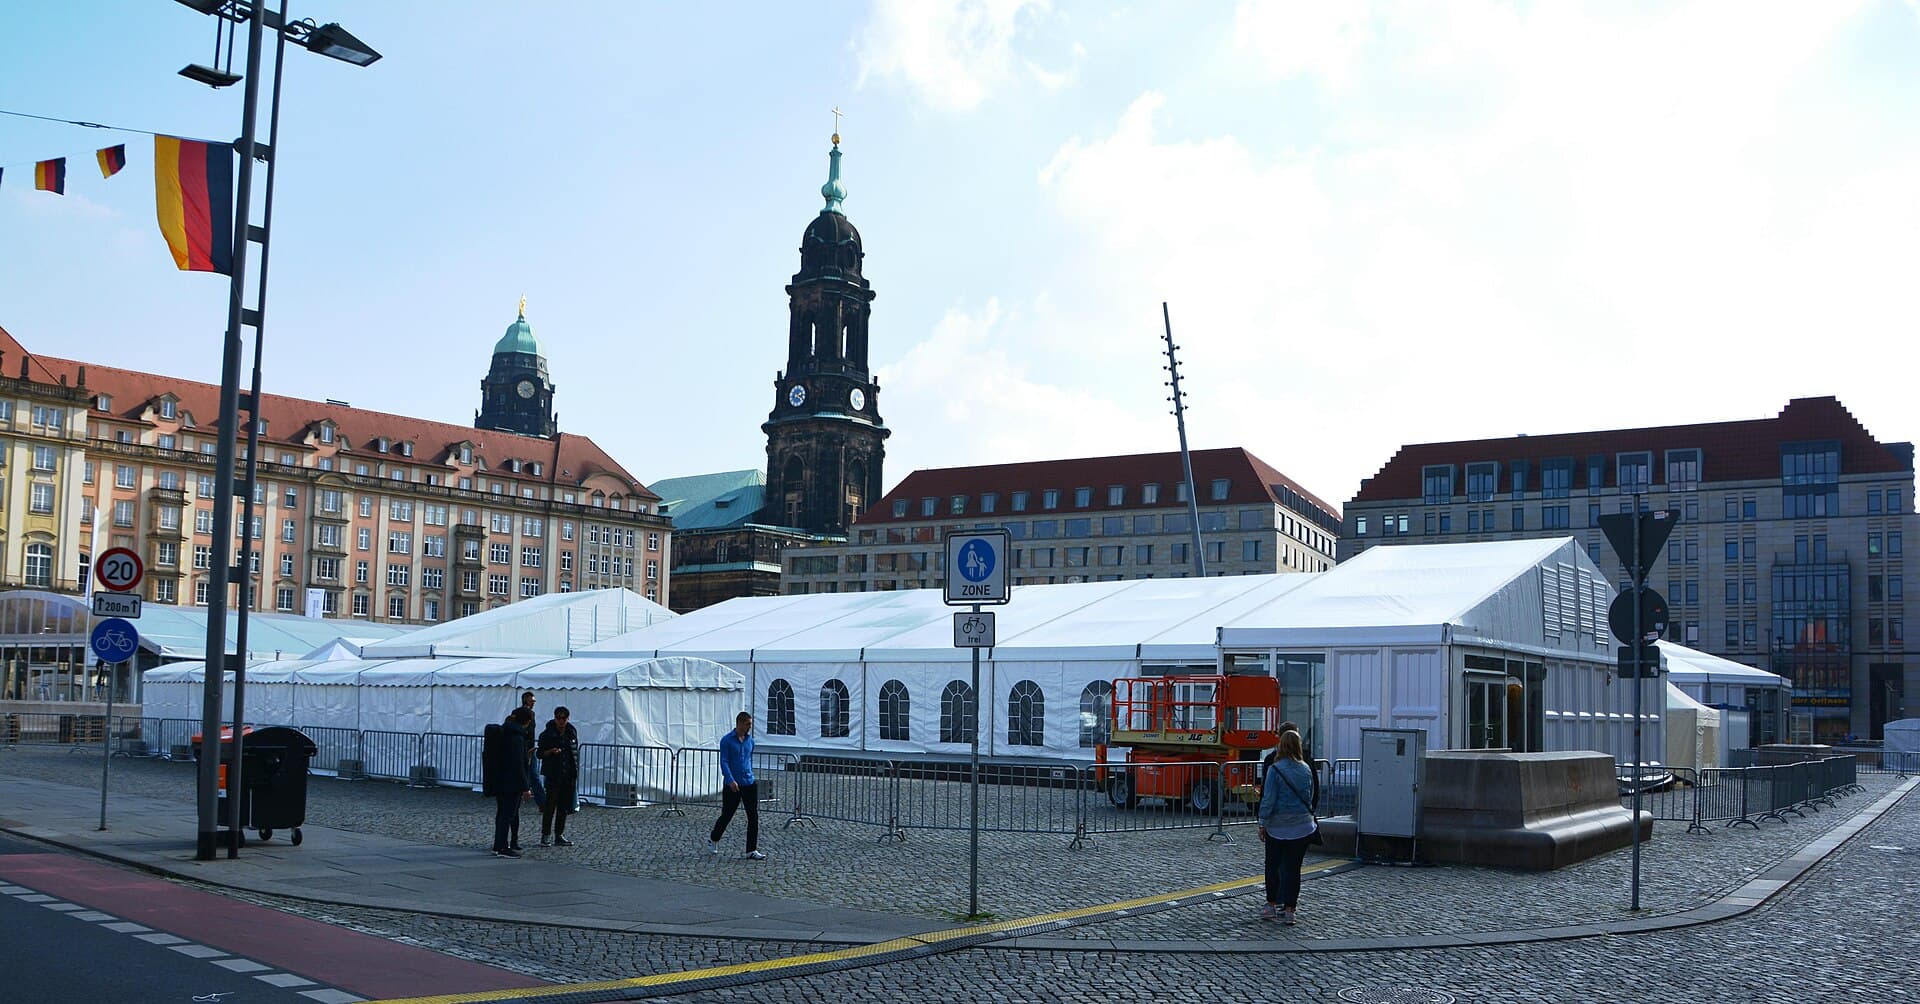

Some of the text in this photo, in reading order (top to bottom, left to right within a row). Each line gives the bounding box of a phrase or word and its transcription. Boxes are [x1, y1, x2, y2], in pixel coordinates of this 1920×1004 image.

[107, 560, 133, 581] 20
[962, 585, 990, 595] ZONE
[1188, 733, 1203, 741] JLG
